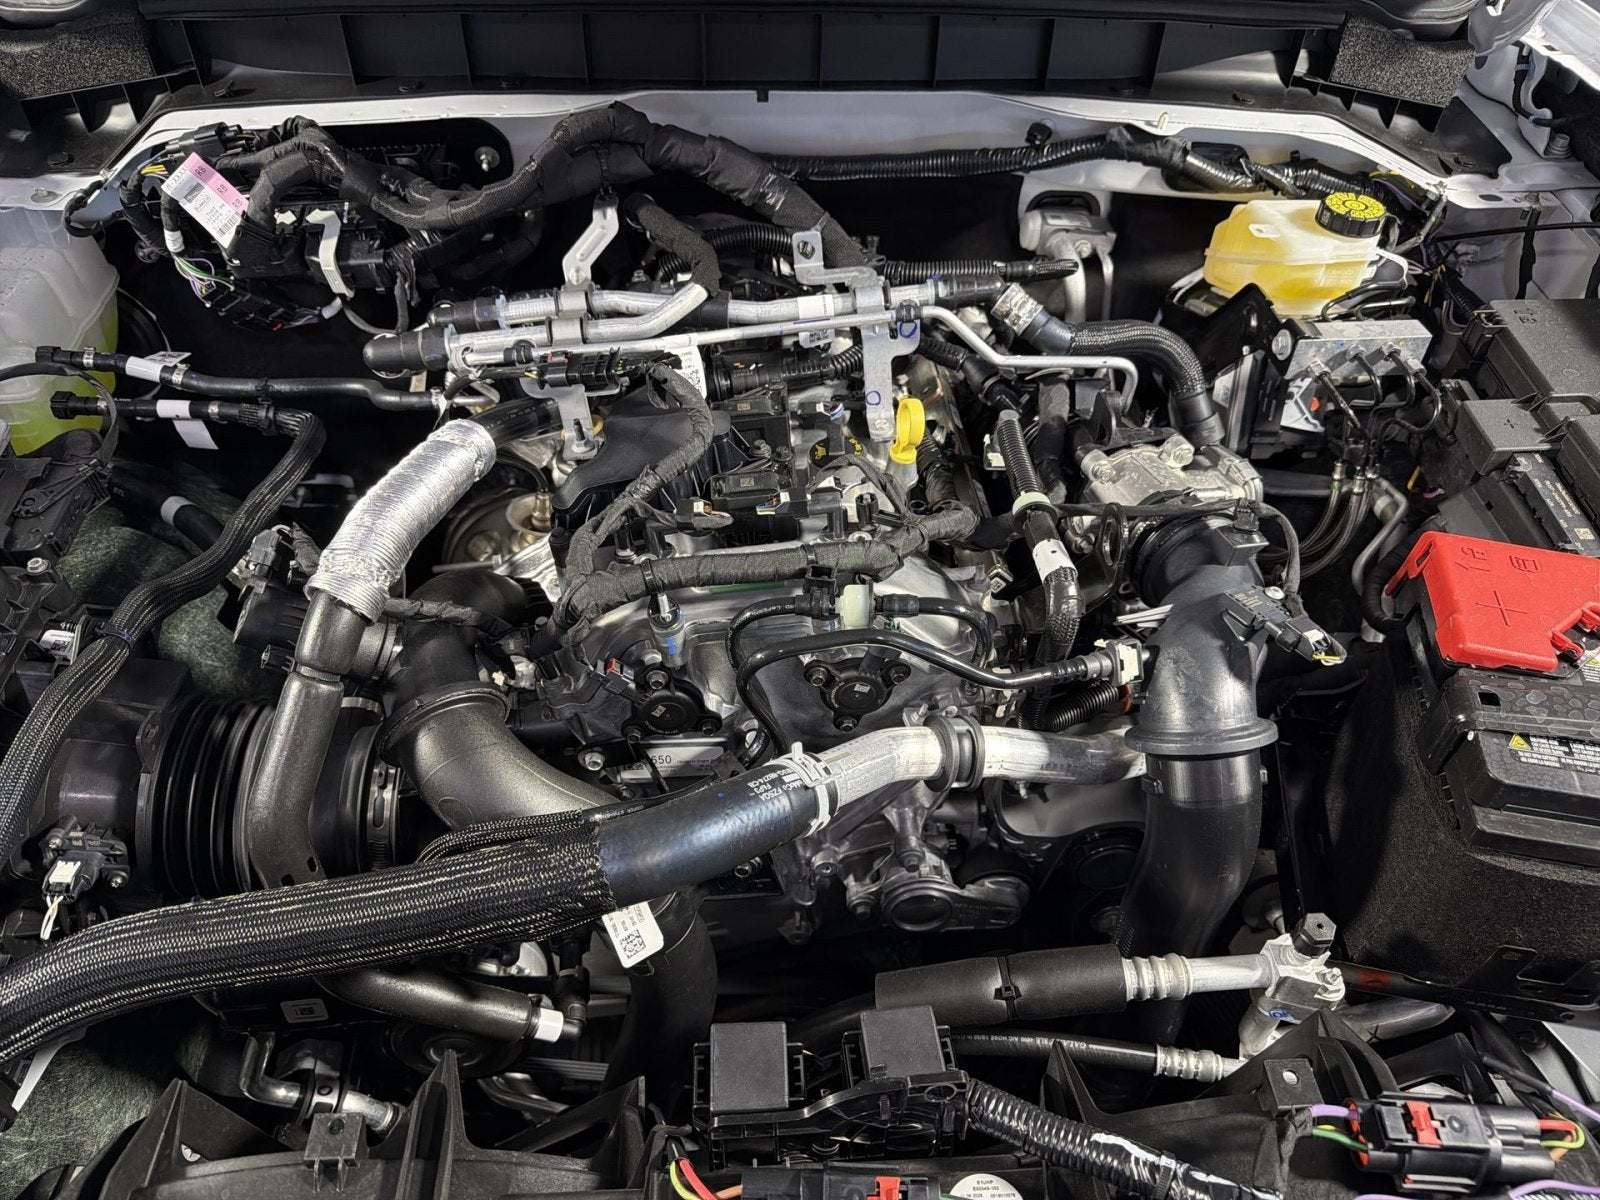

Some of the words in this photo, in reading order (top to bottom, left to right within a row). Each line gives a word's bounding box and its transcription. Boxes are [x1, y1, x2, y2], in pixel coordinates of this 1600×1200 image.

[194, 165, 207, 177] RB
[216, 184, 228, 195] RB
[232, 198, 243, 209] RB
[781, 779, 805, 792] oMoCo
[990, 1034, 1008, 1042] HOSE
